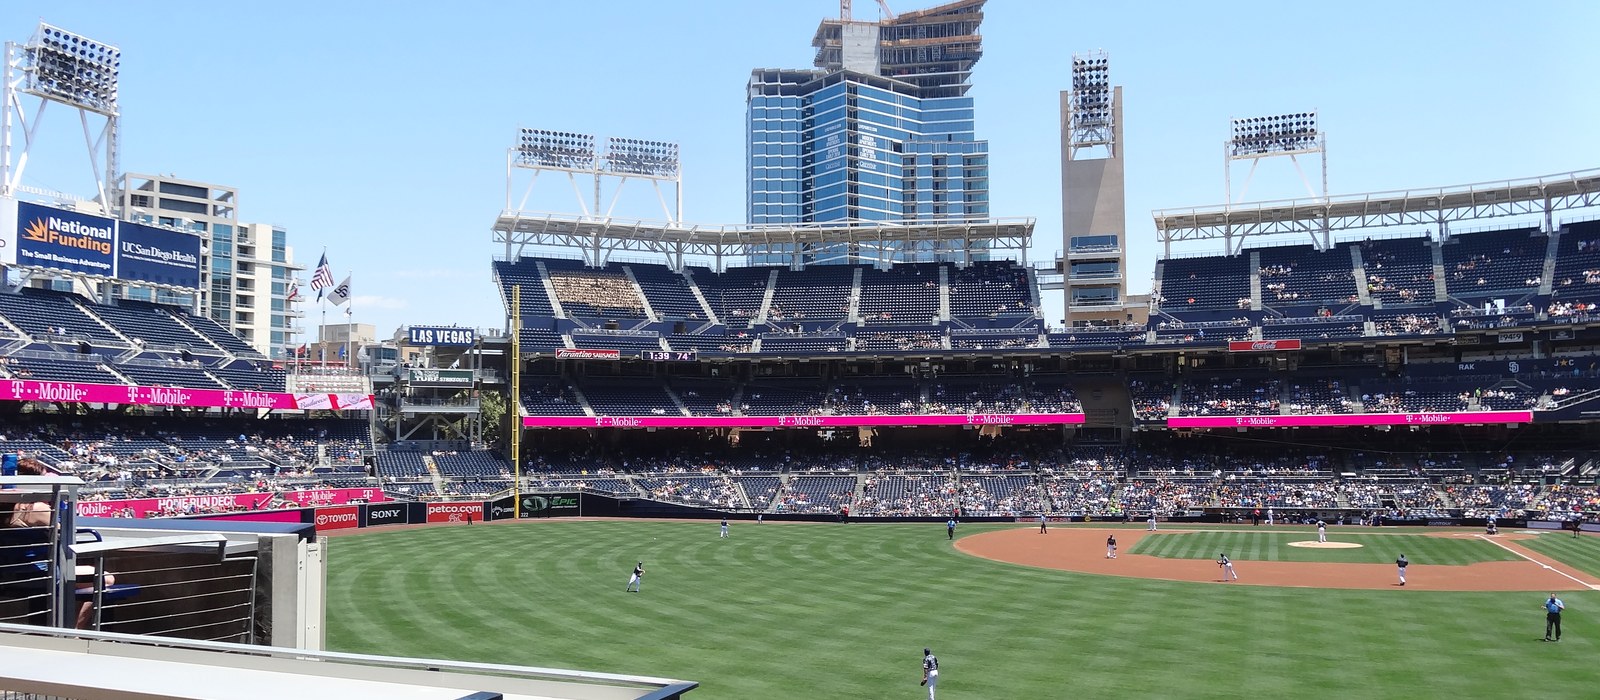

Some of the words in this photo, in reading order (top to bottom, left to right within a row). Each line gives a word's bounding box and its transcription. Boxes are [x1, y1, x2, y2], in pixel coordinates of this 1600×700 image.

[50, 216, 111, 240] National
[49, 231, 111, 254] Funding
[122, 241, 136, 253] UC
[136, 244, 150, 255] San
[151, 247, 172, 260] Diego
[172, 251, 196, 263] Health
[22, 249, 33, 257] The
[34, 251, 51, 260] Small
[53, 254, 78, 264] Business
[79, 259, 111, 270] Advantage
[412, 330, 433, 342] LAS
[436, 330, 472, 344] VEGAS
[158, 498, 188, 510] HOME
[192, 498, 210, 508] RUN
[212, 496, 236, 506] DECK
[428, 503, 482, 515] petco.com
[328, 514, 357, 522] TOYOTA
[371, 510, 401, 519] SONY
